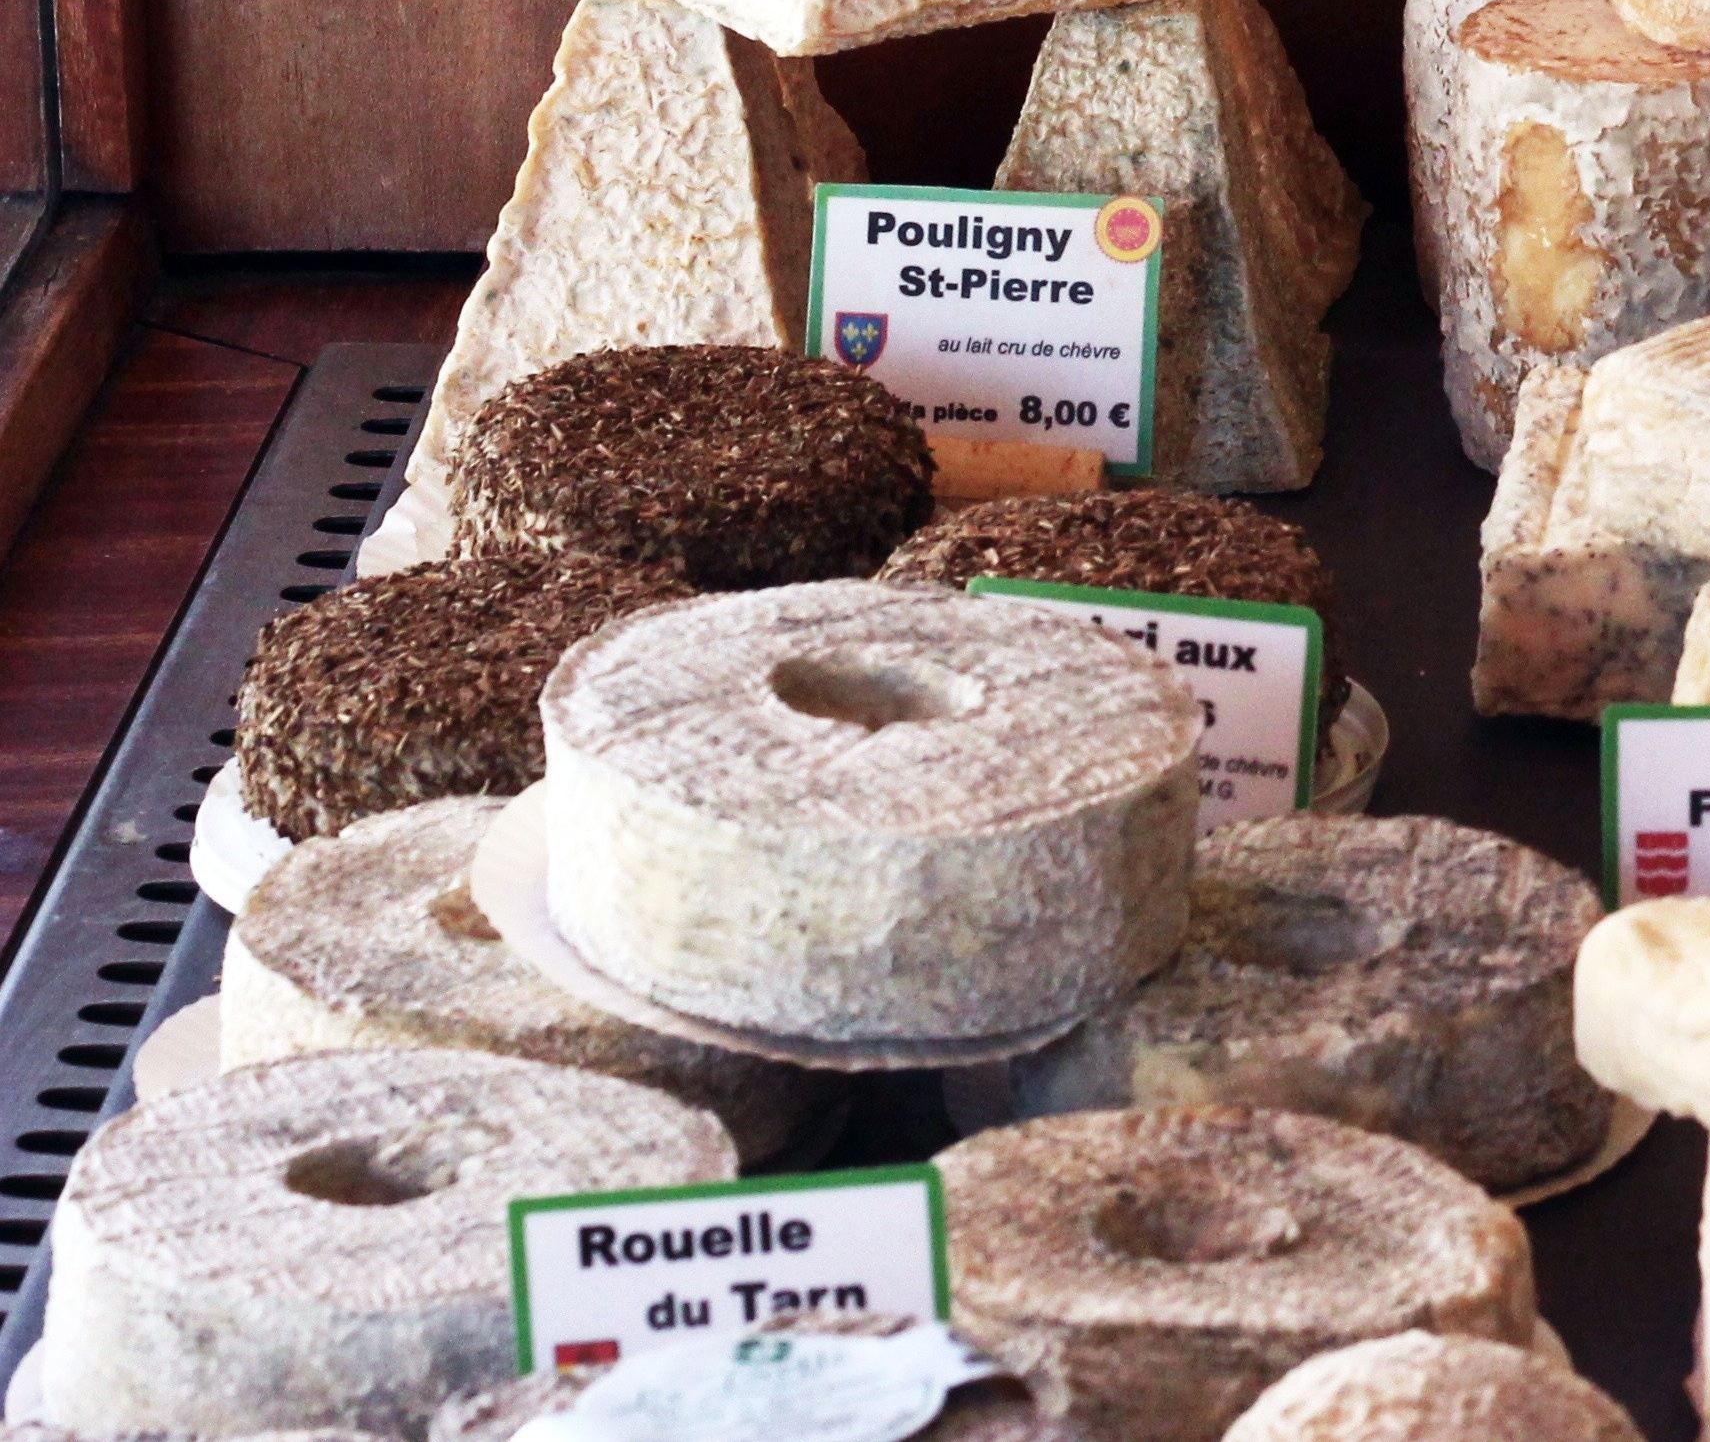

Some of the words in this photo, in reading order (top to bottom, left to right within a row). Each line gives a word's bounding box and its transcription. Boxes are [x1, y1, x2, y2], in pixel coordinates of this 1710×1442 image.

[866, 210, 1073, 263] Pouligny
[898, 265, 1095, 306] St-Pierre
[938, 338, 961, 354] au
[965, 337, 993, 355] lait
[997, 341, 1027, 357] cru
[1031, 340, 1054, 357] de
[1059, 340, 1122, 361] chèvre
[932, 401, 999, 425] pièce
[1018, 394, 1098, 431] 8,00
[1108, 401, 1131, 429] €
[1174, 637, 1258, 674] aux
[577, 1210, 814, 1269] Rouelle
[646, 1292, 712, 1331] du
[730, 1280, 869, 1323] Tarn
